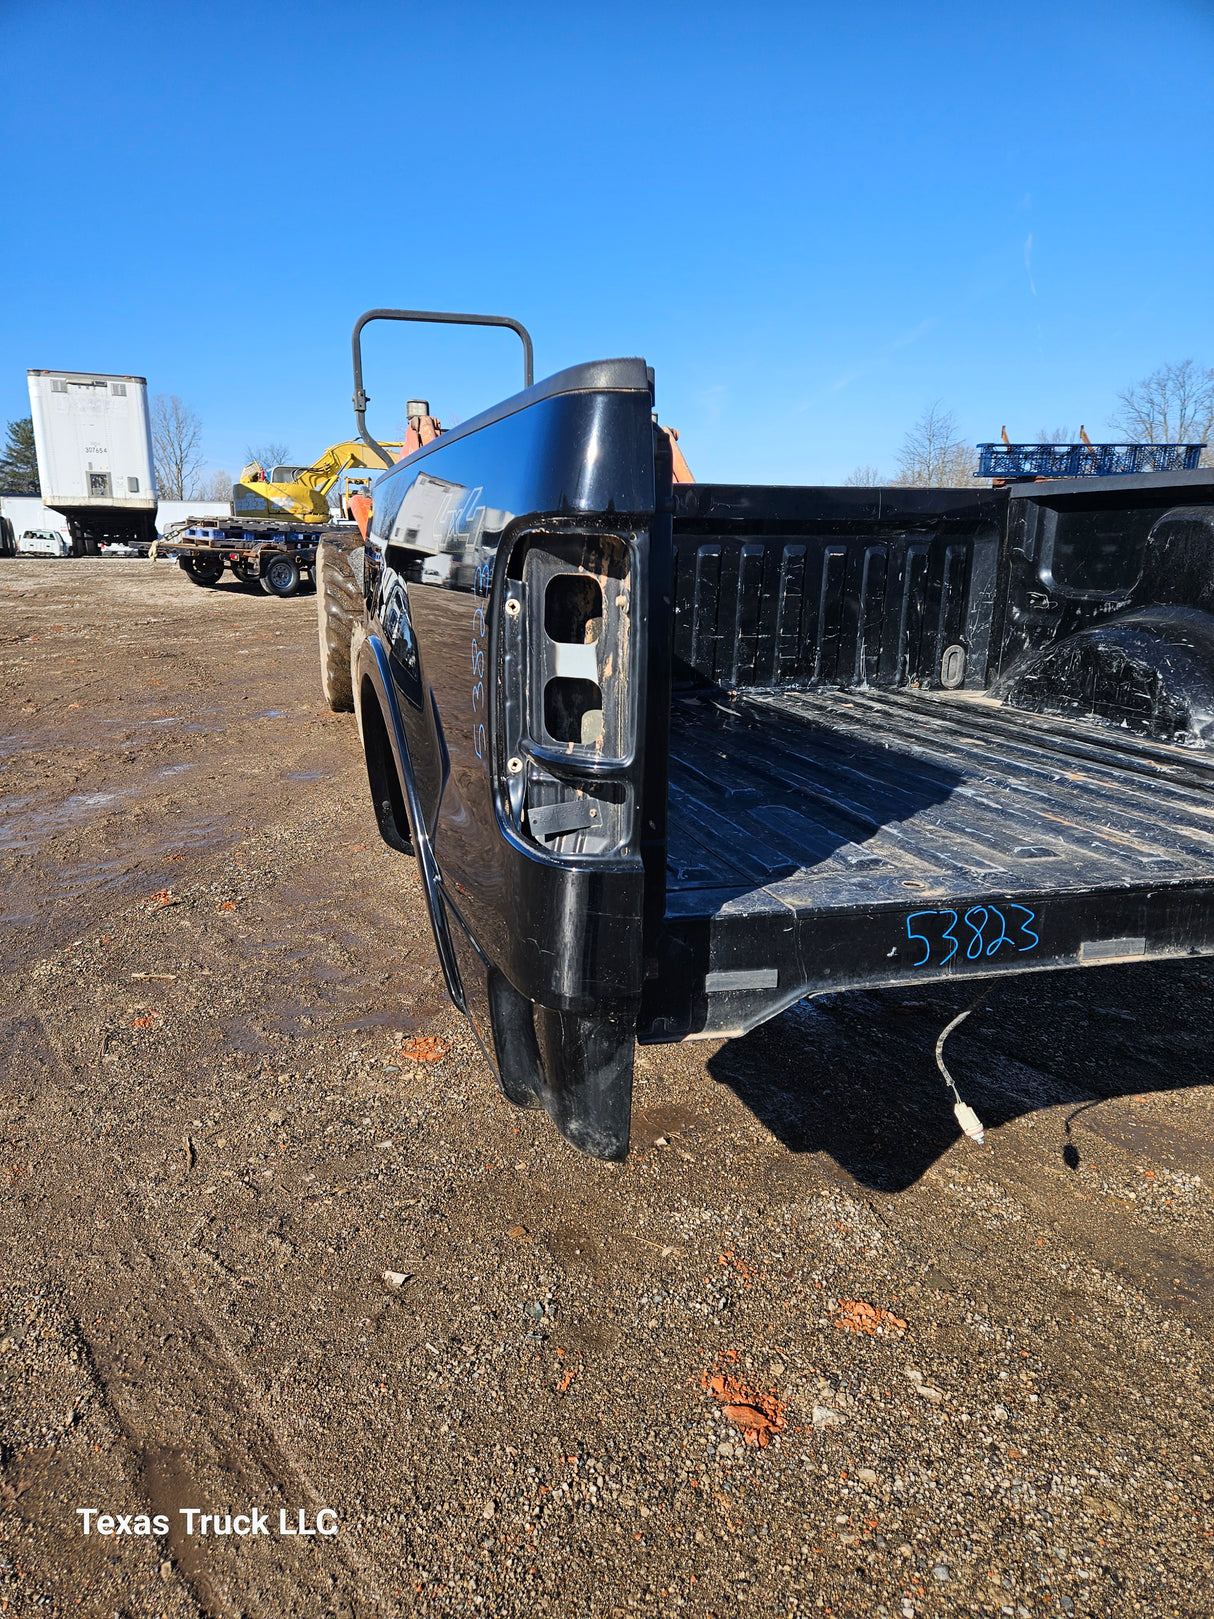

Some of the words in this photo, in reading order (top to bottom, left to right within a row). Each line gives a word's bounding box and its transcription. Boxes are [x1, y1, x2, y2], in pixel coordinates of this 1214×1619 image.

[84, 446, 108, 454] 307654
[471, 564, 490, 759] 53823
[906, 903, 1039, 967] 53823
